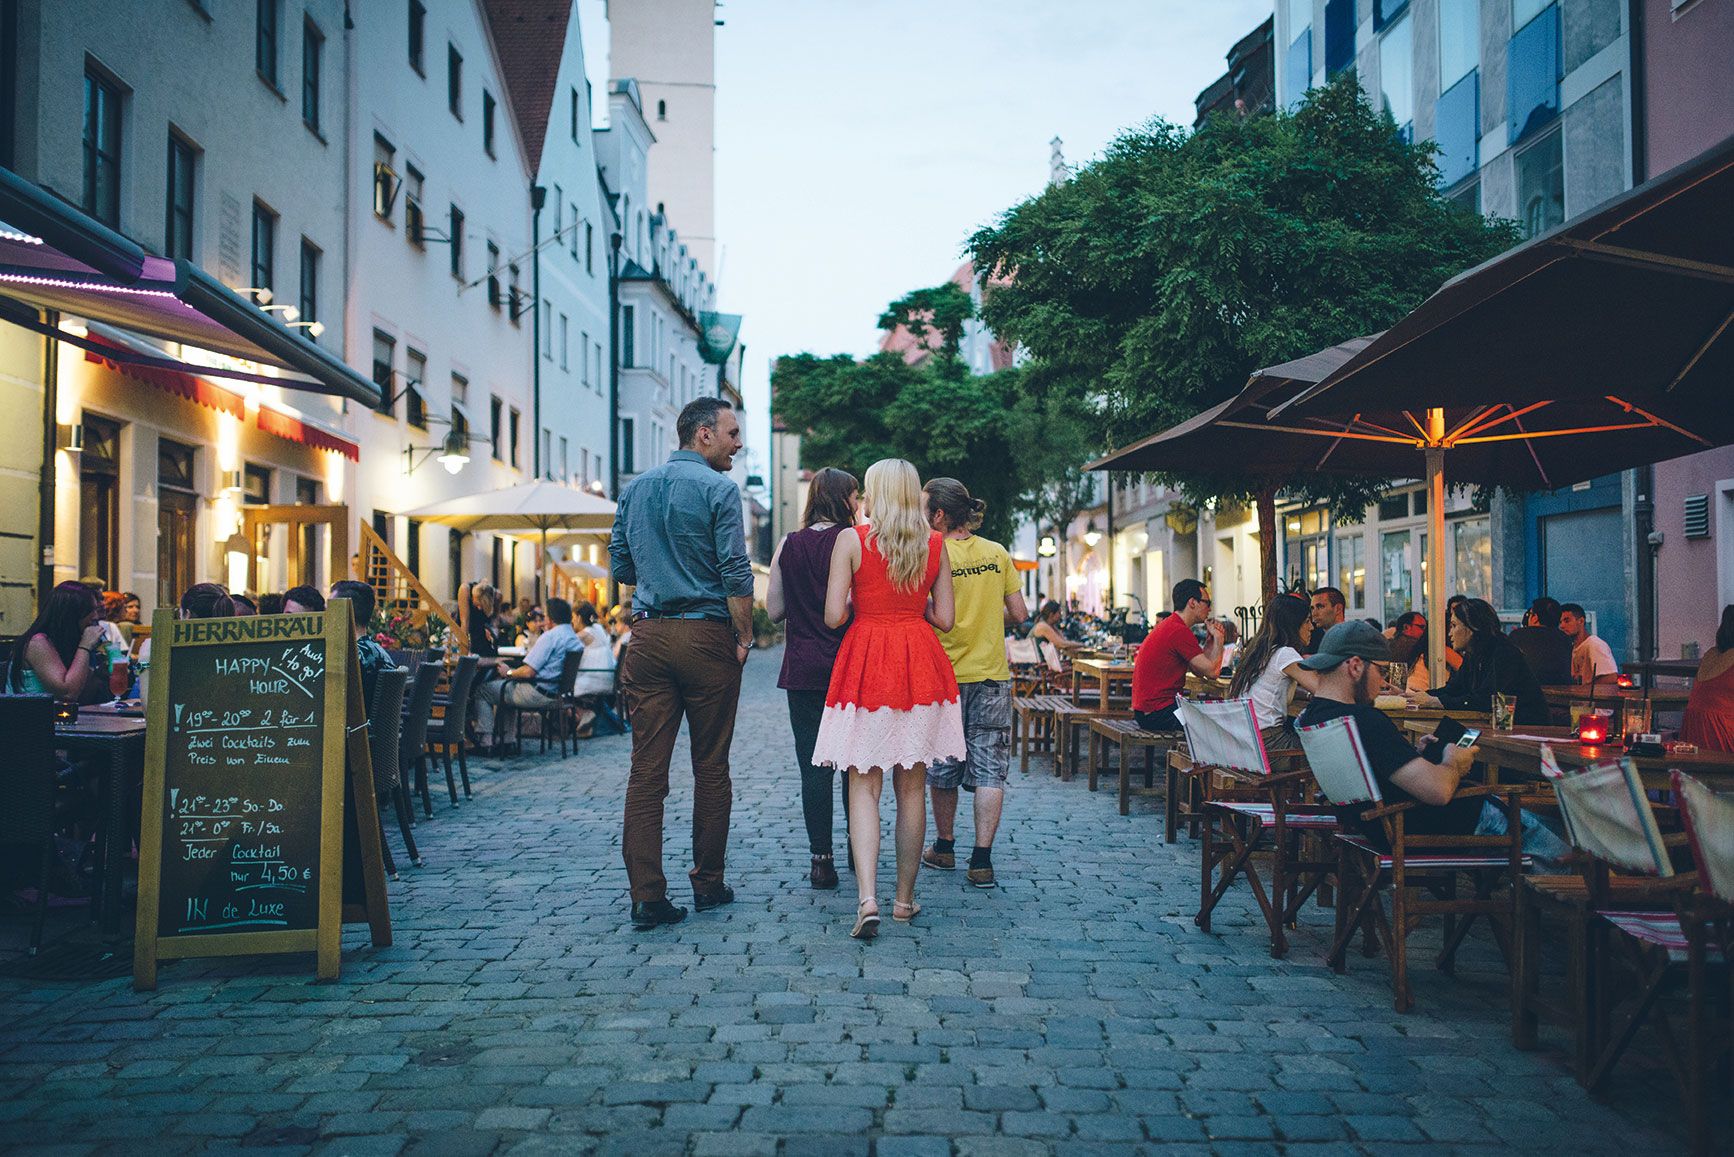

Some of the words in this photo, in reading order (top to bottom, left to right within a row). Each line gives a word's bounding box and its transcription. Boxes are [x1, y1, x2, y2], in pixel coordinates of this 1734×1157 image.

[174, 616, 323, 643] HERRNBRÄU
[300, 643, 324, 664] Auch
[216, 658, 270, 675] HAPPY
[287, 655, 299, 670] to
[298, 665, 324, 682] go!
[250, 679, 290, 694] HOUR
[260, 710, 272, 726] 2
[279, 709, 299, 727] für
[304, 711, 314, 723] 1
[188, 736, 214, 749] Zwei
[222, 736, 276, 748] Cocktails
[287, 738, 310, 747] zum
[188, 752, 216, 764] Preis
[226, 756, 245, 765] von
[254, 753, 290, 764] Einem
[183, 843, 217, 861] Jeder
[232, 844, 280, 859] Cocktail
[230, 871, 250, 882] nur
[261, 862, 298, 885] 4,50
[186, 897, 209, 921] IN
[222, 902, 240, 919] de
[248, 898, 285, 916] Luxe
